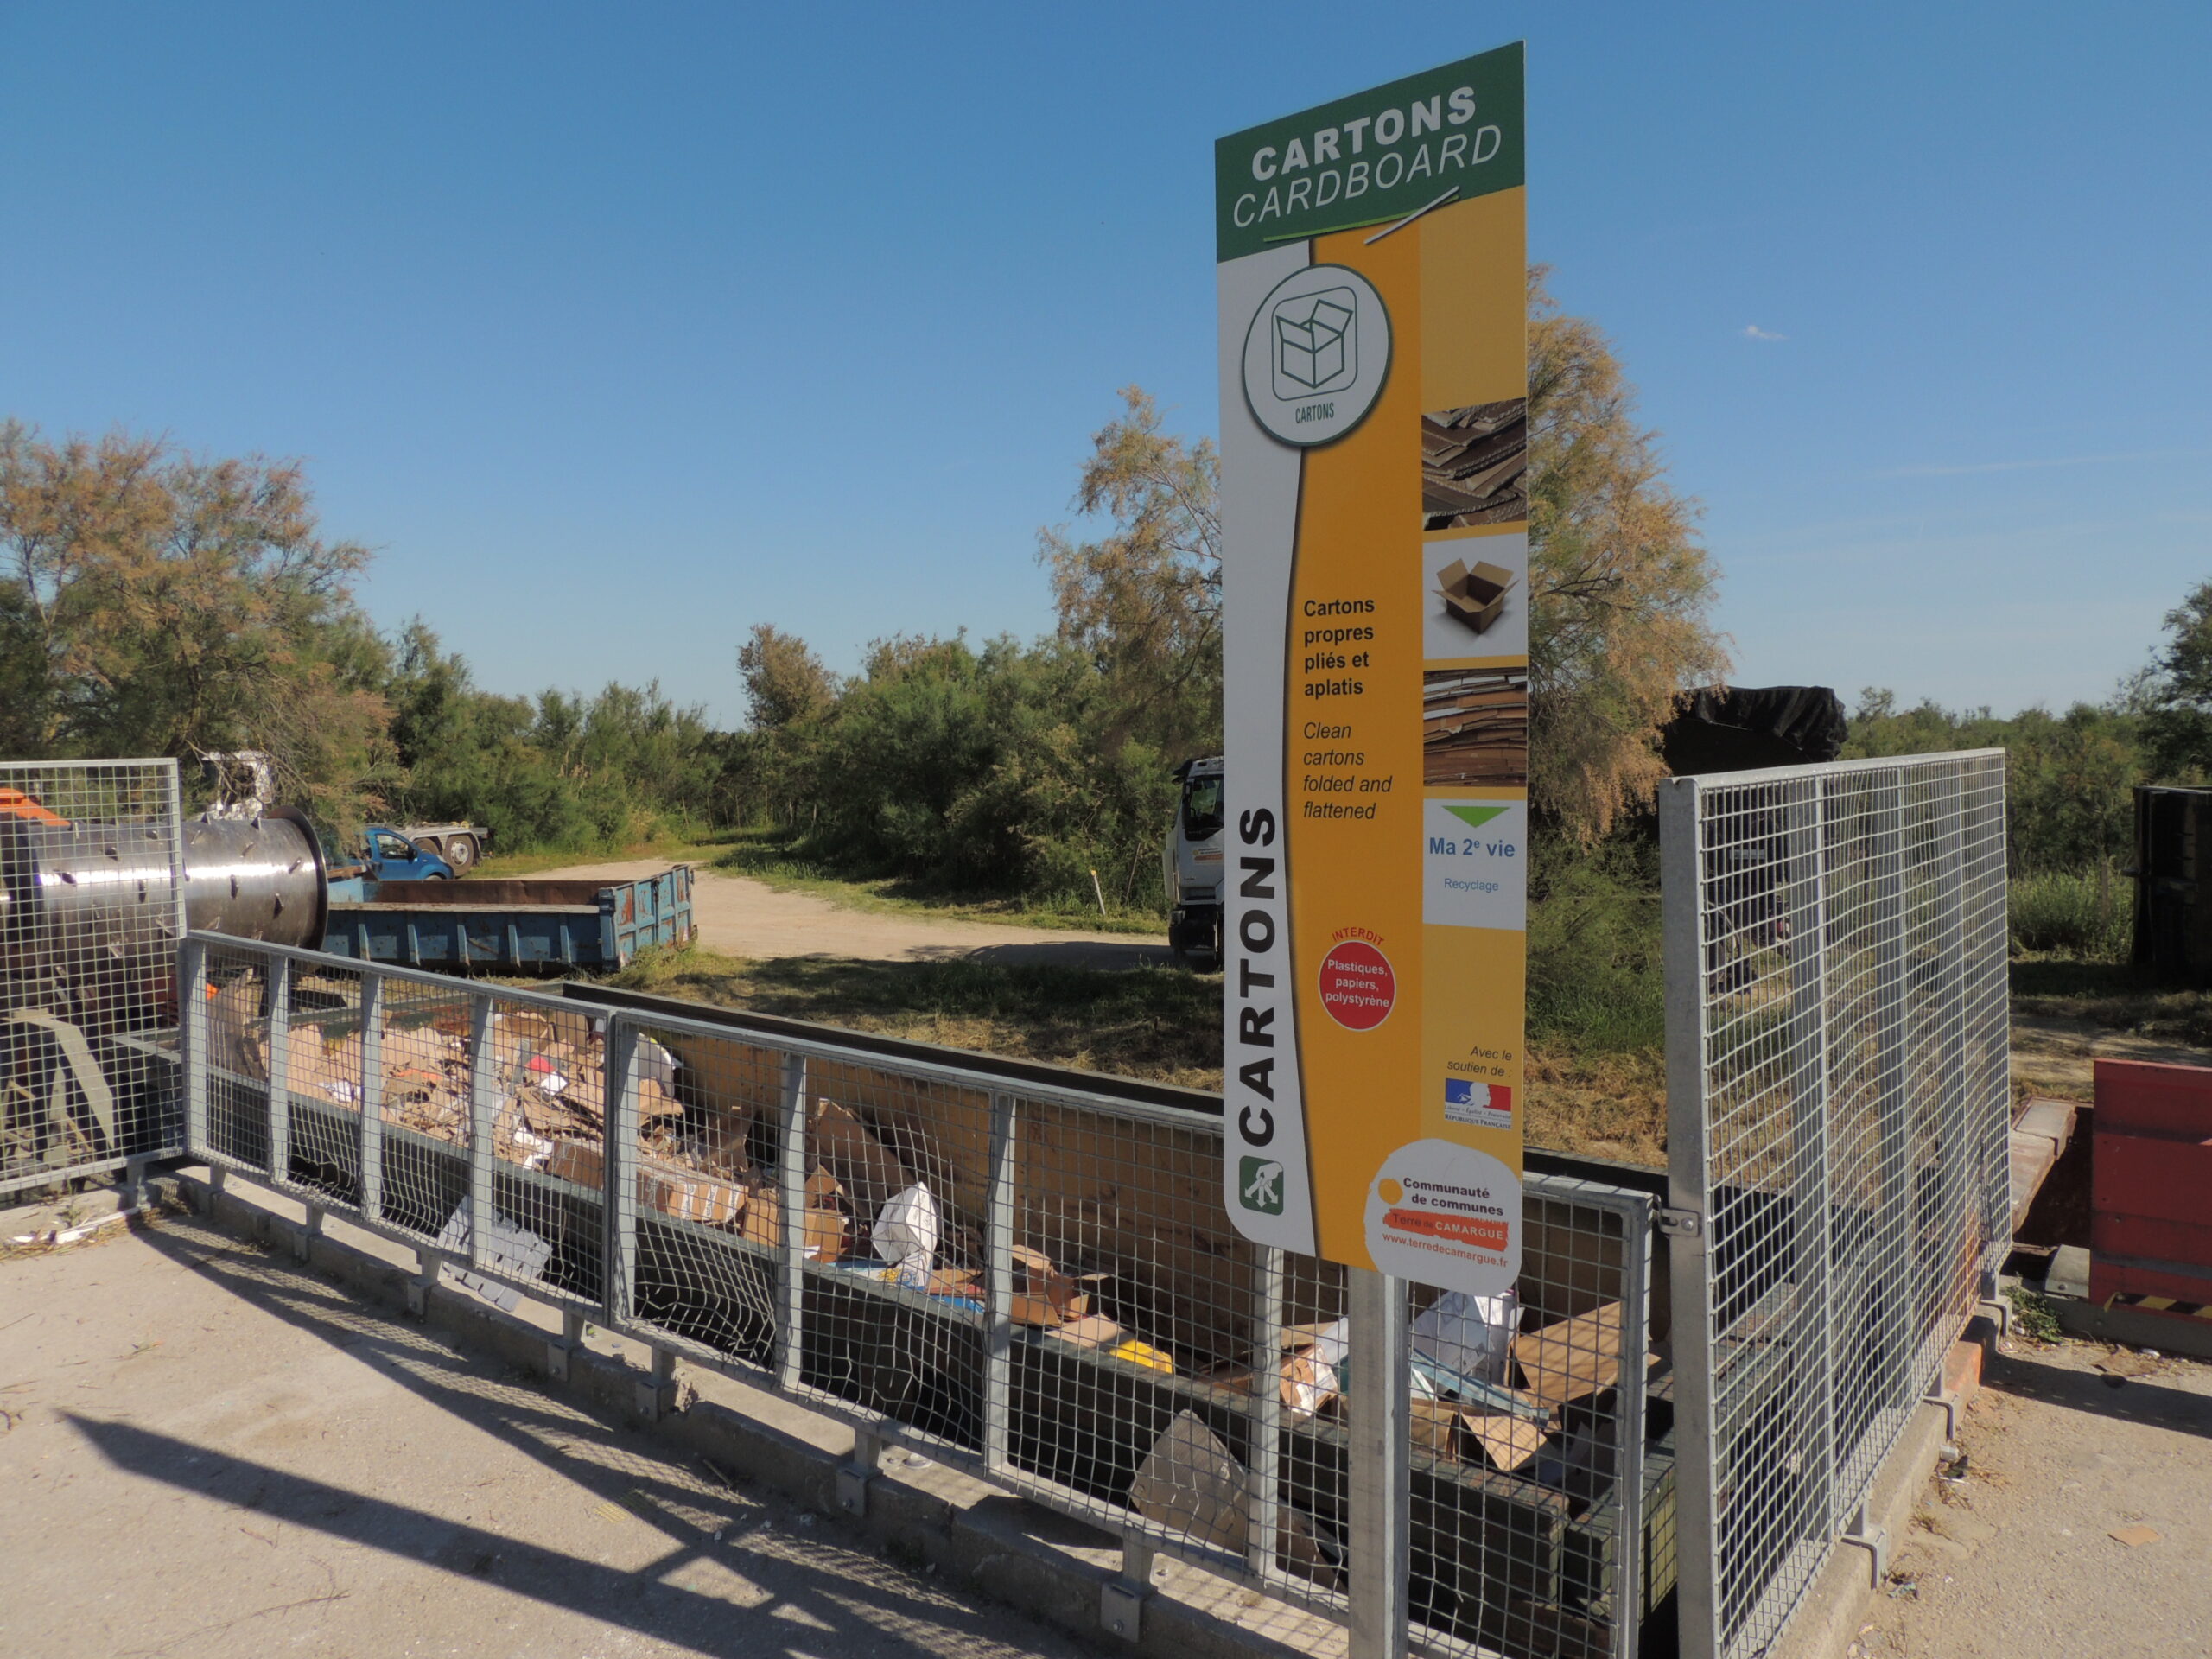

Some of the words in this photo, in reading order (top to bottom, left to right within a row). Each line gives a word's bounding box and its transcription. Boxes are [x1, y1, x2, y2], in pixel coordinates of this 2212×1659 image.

[1252, 86, 1476, 181] CARTONS
[1233, 124, 1502, 227] CARDBOARD
[1295, 403, 1334, 423] CARTONS
[1303, 598, 1375, 617] Cartons
[1304, 625, 1374, 647] propres
[1304, 652, 1346, 674] pliés
[1351, 651, 1370, 667] et
[1304, 679, 1363, 700] aplatis
[1303, 722, 1351, 739] Clean
[1303, 749, 1364, 766] cartons
[1303, 776, 1353, 792] folded
[1359, 776, 1392, 793] and
[1303, 802, 1376, 820] flattened
[1429, 836, 1456, 855] Ma
[1486, 839, 1516, 857] vie
[1444, 878, 1499, 893] Recyclage
[1332, 926, 1384, 946] INTERDIT
[1239, 807, 1275, 1147] CARTONS
[1327, 959, 1388, 976] Plastiques,
[1335, 978, 1379, 992] papiers,
[1325, 992, 1389, 1007] polystyrène
[1470, 1046, 1498, 1059] Avec
[1502, 1050, 1512, 1061] le
[1447, 1061, 1487, 1075] soutien
[1491, 1065, 1505, 1077] de
[1403, 1177, 1490, 1199] Communauté
[1411, 1192, 1427, 1205] de
[1431, 1197, 1503, 1217] communes
[1393, 1212, 1422, 1227] Terre
[1435, 1220, 1503, 1240] CAMARGUE
[1382, 1233, 1509, 1268] www.terredecamargue.fr
